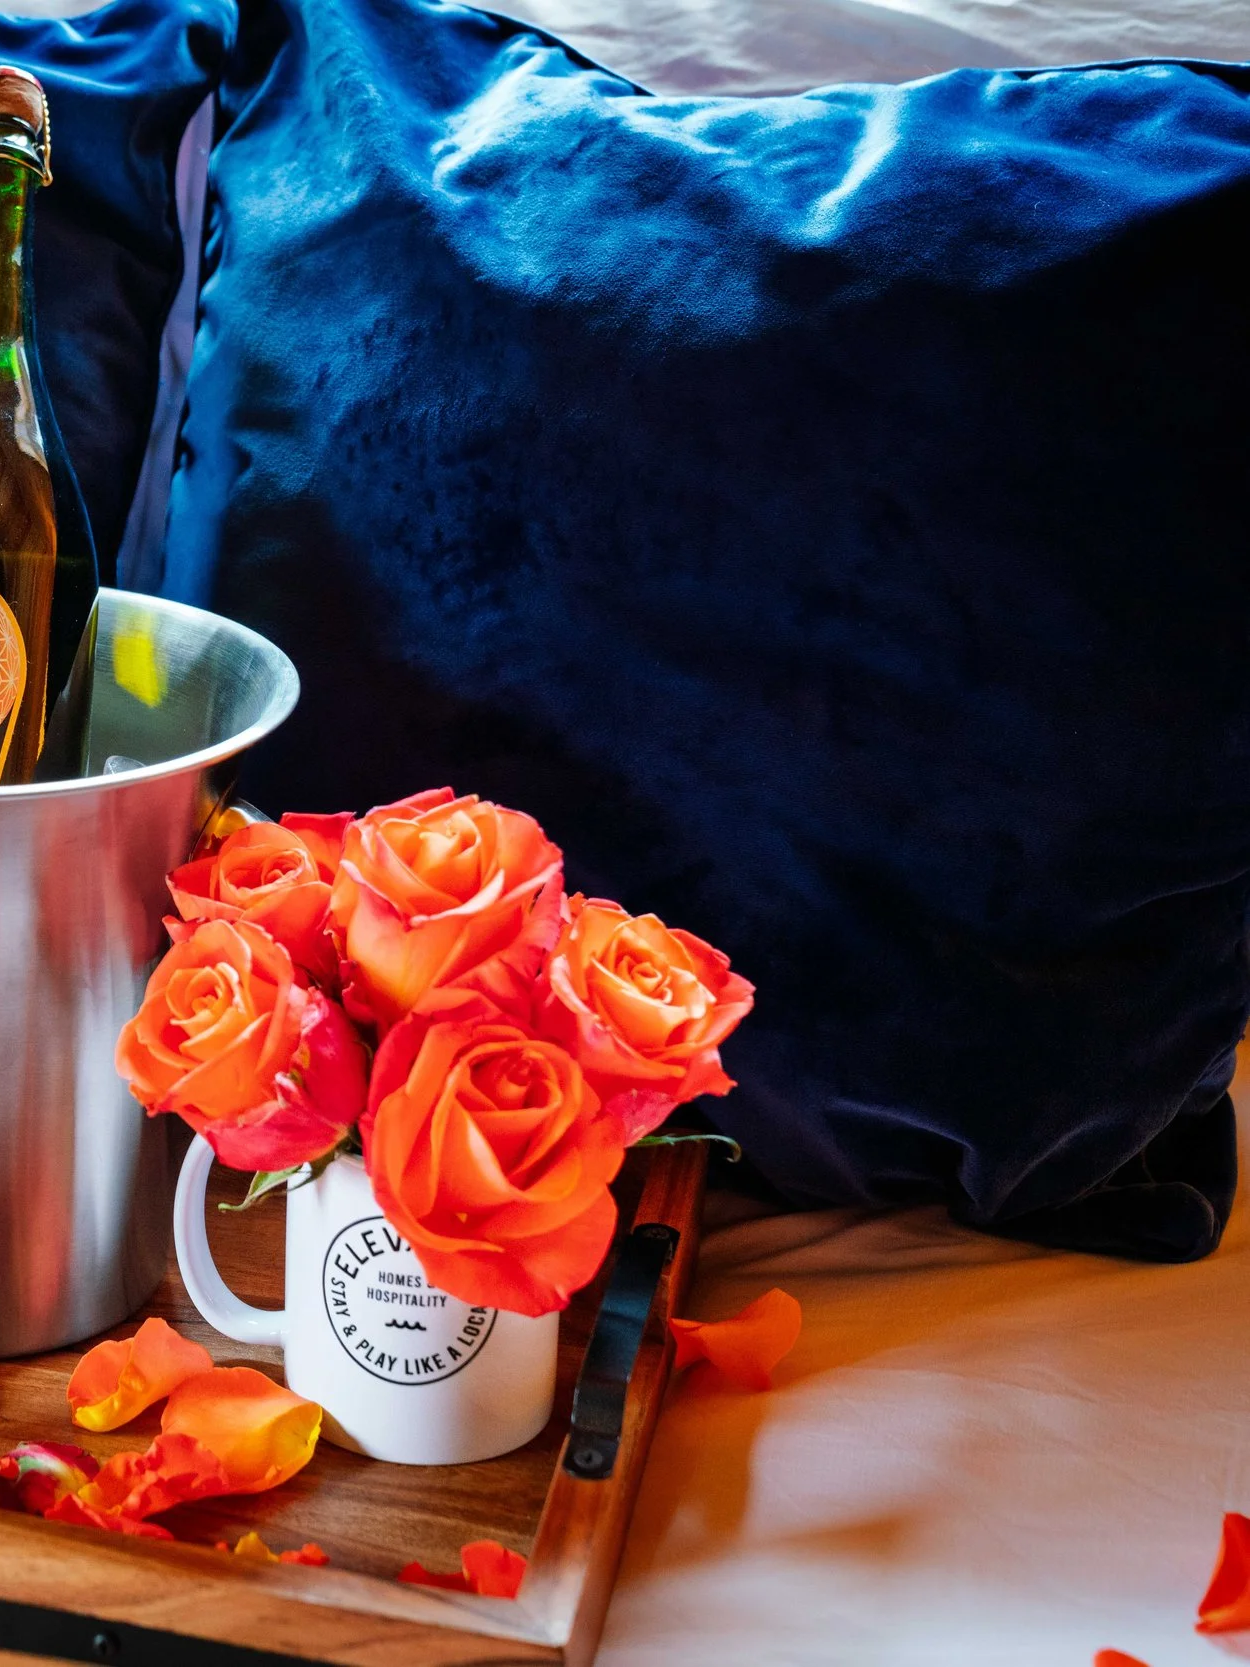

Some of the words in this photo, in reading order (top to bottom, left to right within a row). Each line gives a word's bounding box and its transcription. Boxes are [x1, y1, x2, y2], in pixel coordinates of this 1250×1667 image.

[334, 1226, 411, 1280] ELEV
[366, 1287, 447, 1308] HOSPITALITY
[378, 1271, 422, 1288] HOMES
[331, 1277, 351, 1317] STAY
[343, 1324, 357, 1338] &
[355, 1339, 398, 1372] PLAY
[404, 1353, 446, 1376] LIKE
[446, 1346, 462, 1361] A
[457, 1306, 488, 1347] LOCA
